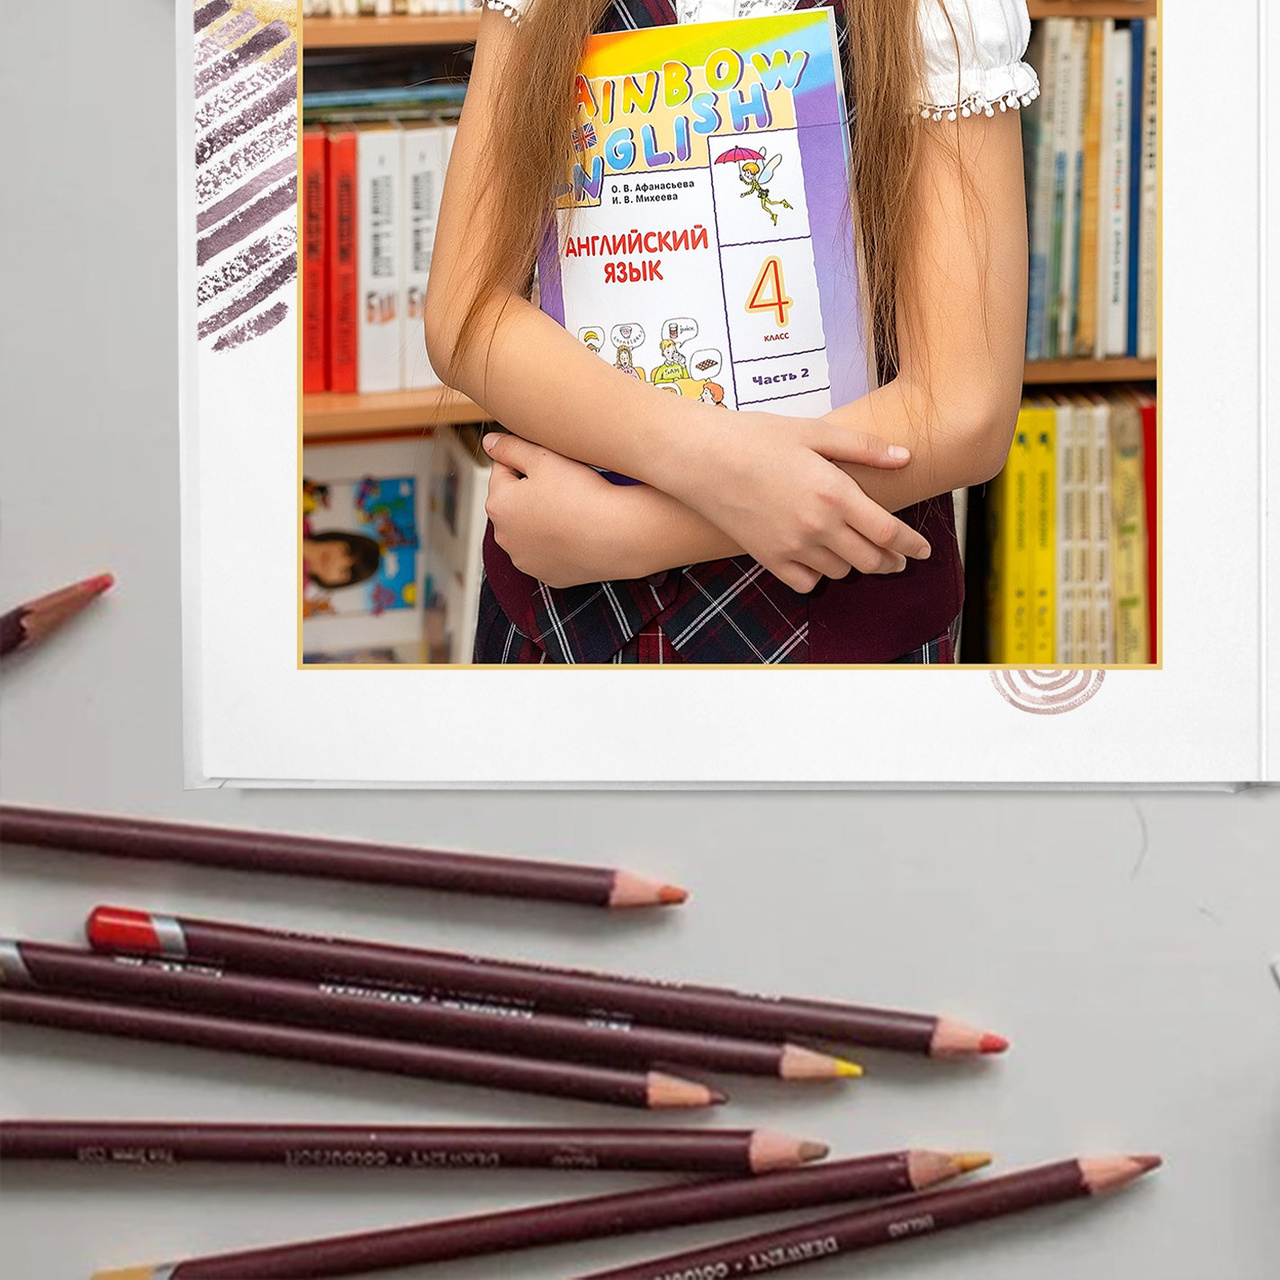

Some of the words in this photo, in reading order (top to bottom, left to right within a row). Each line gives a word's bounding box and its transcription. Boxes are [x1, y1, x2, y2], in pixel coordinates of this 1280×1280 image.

[575, 48, 810, 126] AINBOW
[556, 82, 772, 202] NGLISH
[611, 185, 621, 193] О.
[624, 184, 632, 192] В.
[635, 181, 695, 193] Афанасьева
[612, 196, 621, 204] И.
[624, 195, 633, 203] В.
[636, 192, 678, 203] Михеева
[565, 224, 708, 257] АНГЛИЙСКИЙ
[605, 260, 663, 283] ЯЗЫК
[745, 255, 793, 327] 4
[764, 332, 789, 342] КЛАСС
[665, 367, 680, 376] SAM
[752, 373, 797, 385] Часть
[801, 368, 809, 378] 2
[747, 1236, 839, 1271] DERWENT
